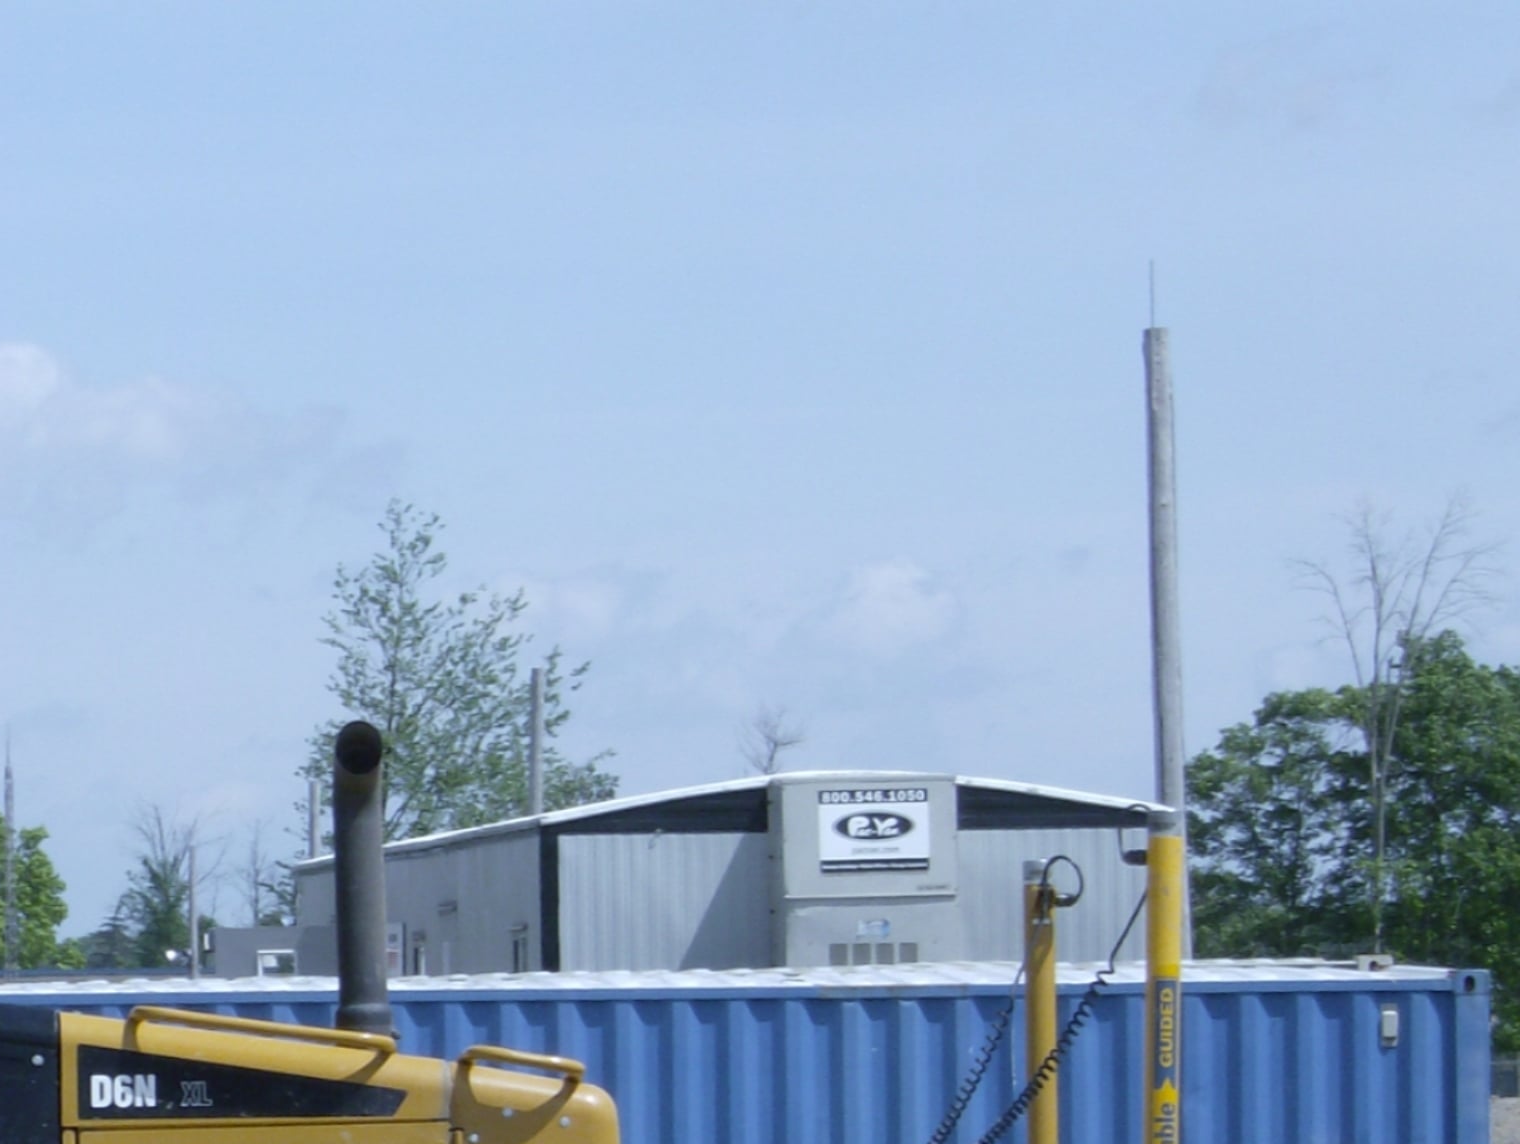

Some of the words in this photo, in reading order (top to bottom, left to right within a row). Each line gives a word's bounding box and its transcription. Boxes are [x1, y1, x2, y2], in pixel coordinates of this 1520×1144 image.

[822, 790, 924, 802] 800.546.1050
[1158, 987, 1174, 1068] GUIDED
[89, 1074, 157, 1108] D6N
[179, 1081, 213, 1107] XL
